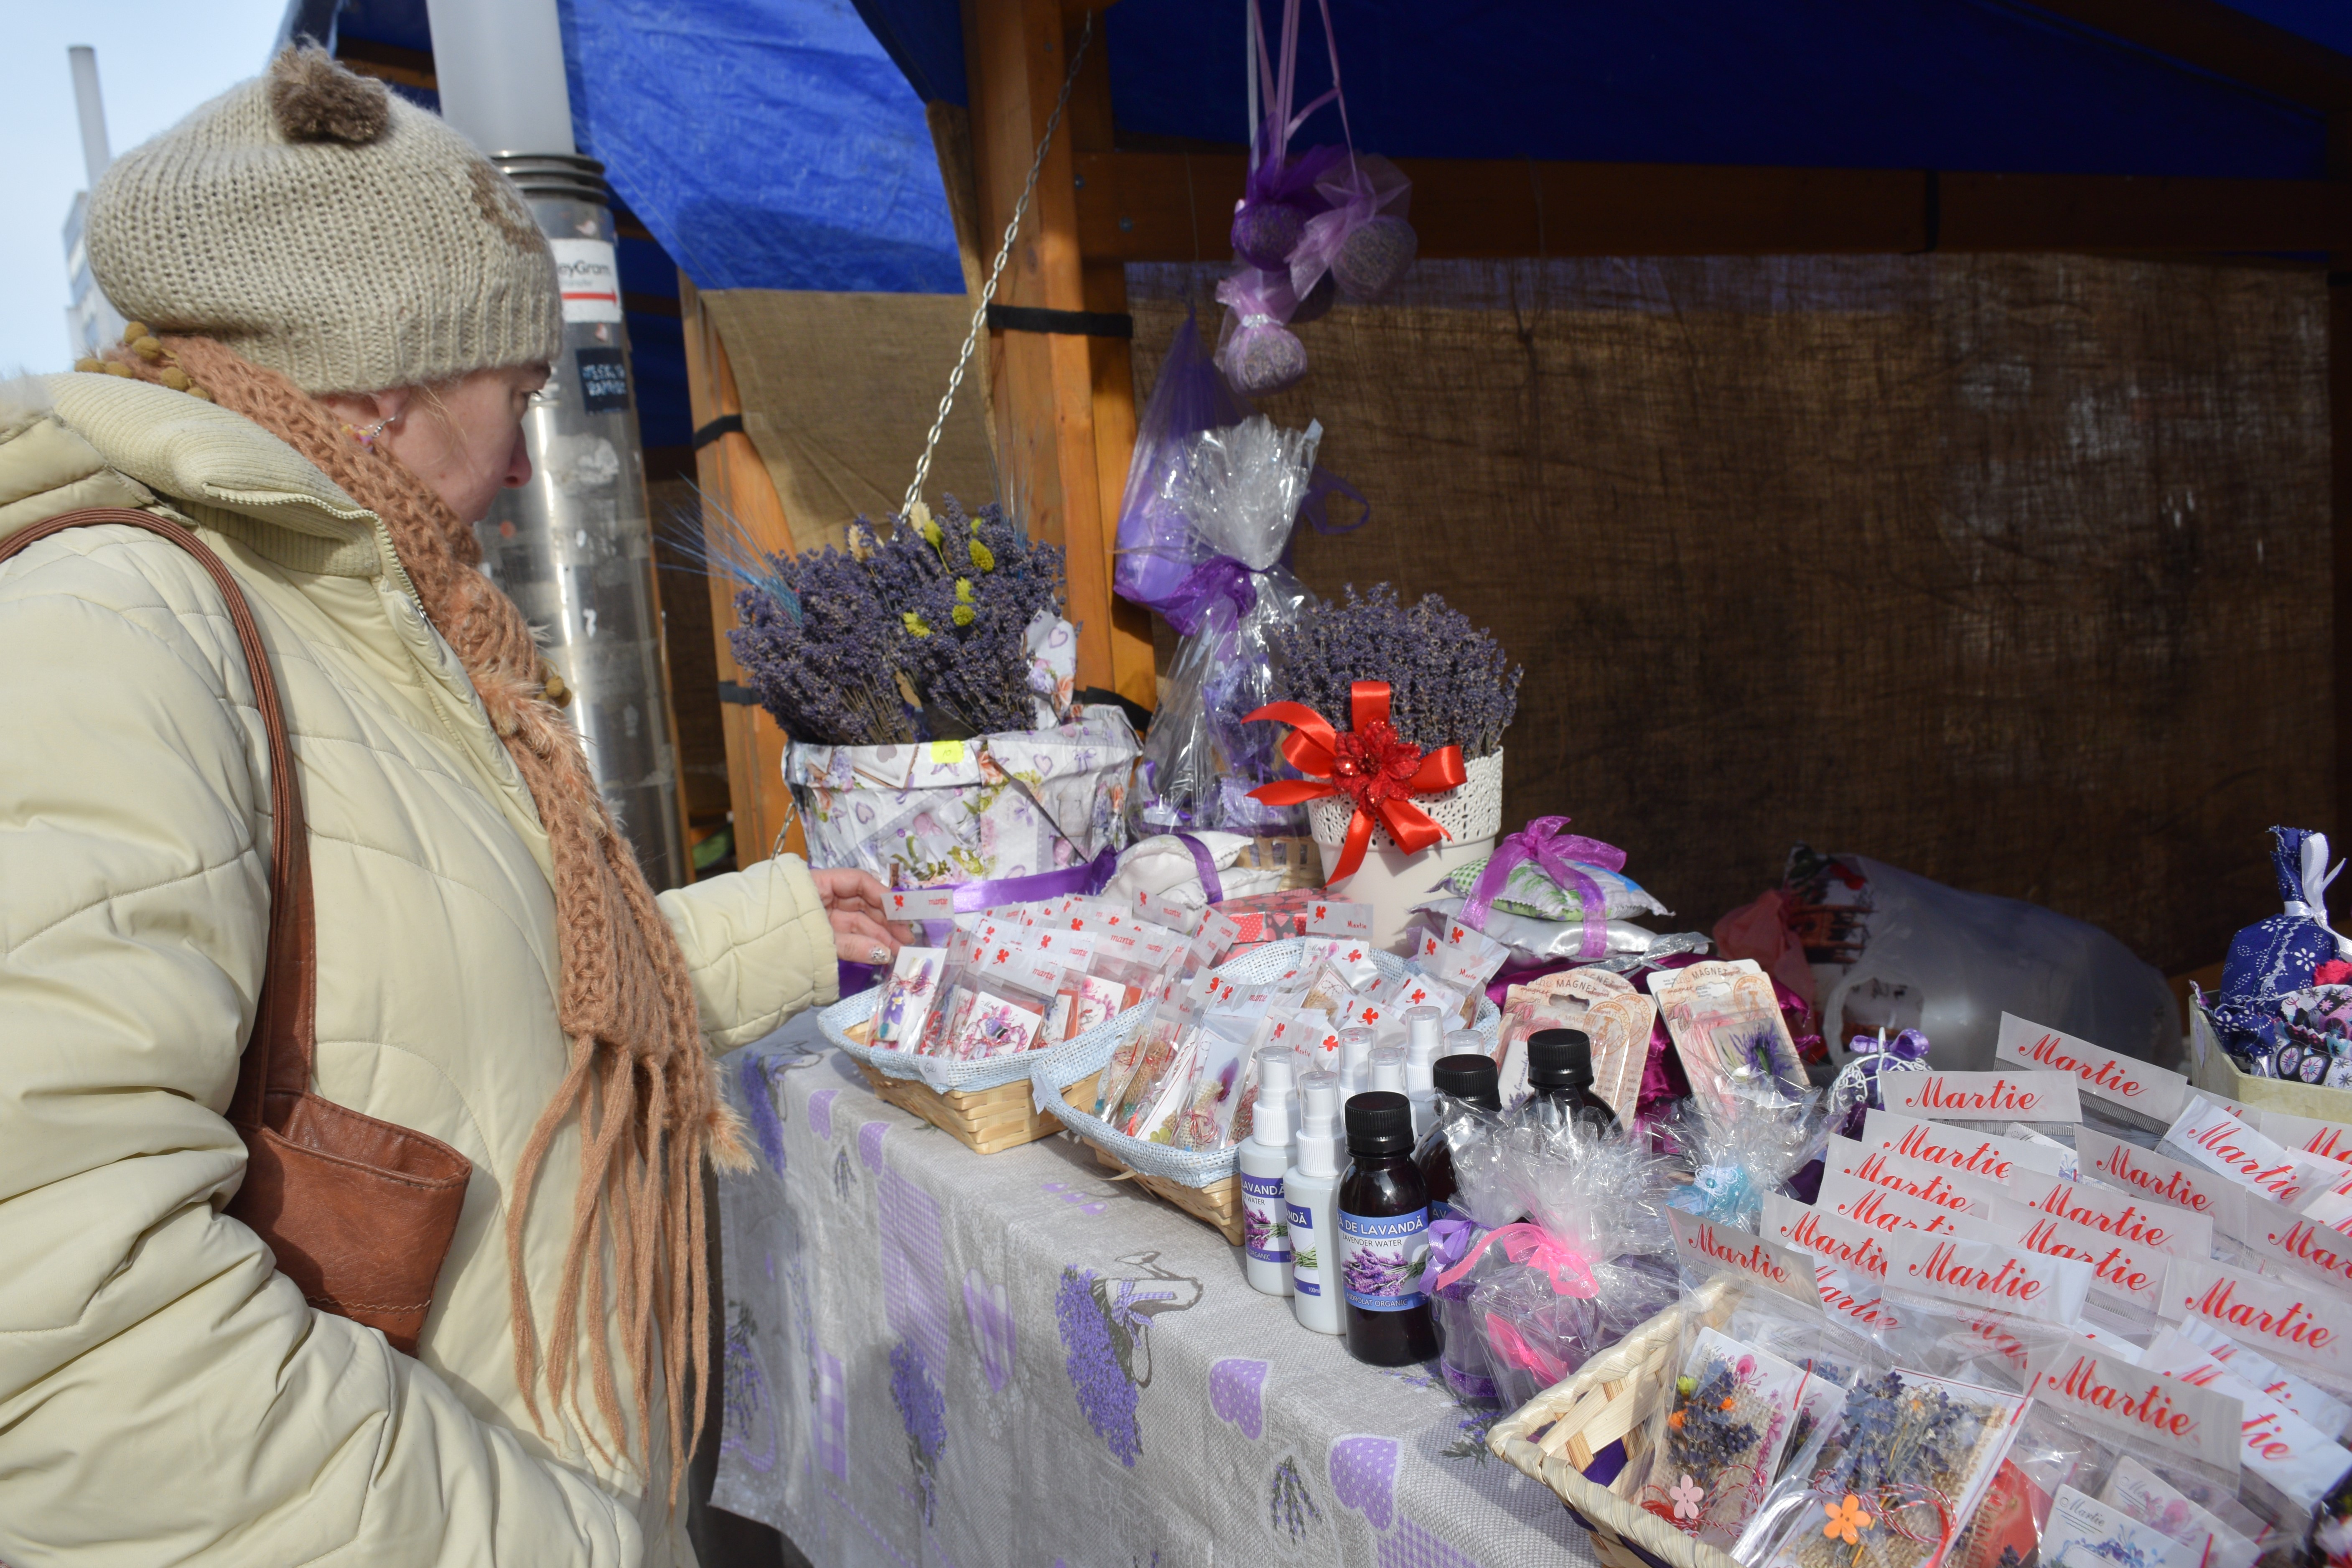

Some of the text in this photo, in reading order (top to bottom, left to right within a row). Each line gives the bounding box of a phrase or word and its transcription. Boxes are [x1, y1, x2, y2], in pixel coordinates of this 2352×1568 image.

[929, 896, 948, 906] martie
[1163, 907, 1181, 918] martie
[1110, 934, 1135, 946] martie
[1146, 943, 1163, 953] martie
[1069, 947, 1088, 957] martie
[1032, 967, 1056, 981] martie
[1691, 967, 1728, 980] MAGNET
[1556, 980, 1597, 994] MAGNET
[1249, 992, 1268, 1002] martie
[2018, 1033, 2148, 1097] Martie
[1905, 1076, 2043, 1111] Martie
[1883, 1124, 2013, 1179] Martie
[2187, 1121, 2300, 1200] Martie
[1845, 1152, 1976, 1211] Martie
[2096, 1145, 2215, 1211] Martie
[1247, 1196, 1265, 1206] WATER
[2029, 1184, 2174, 1247] Martie
[1345, 1219, 1358, 1233] DE
[1361, 1215, 1423, 1236] LAVANDĂ
[1343, 1233, 1373, 1247] LAVENDER
[1250, 1251, 1271, 1260] ORGANIC
[1689, 1223, 1790, 1283] Martie
[1909, 1241, 2050, 1301] Martie
[1347, 1292, 1408, 1307] HIDROLAT ORGANIC
[2185, 1277, 2340, 1348] Martie
[2049, 1356, 2200, 1436] Martie
[2059, 1497, 2105, 1527] Martie
